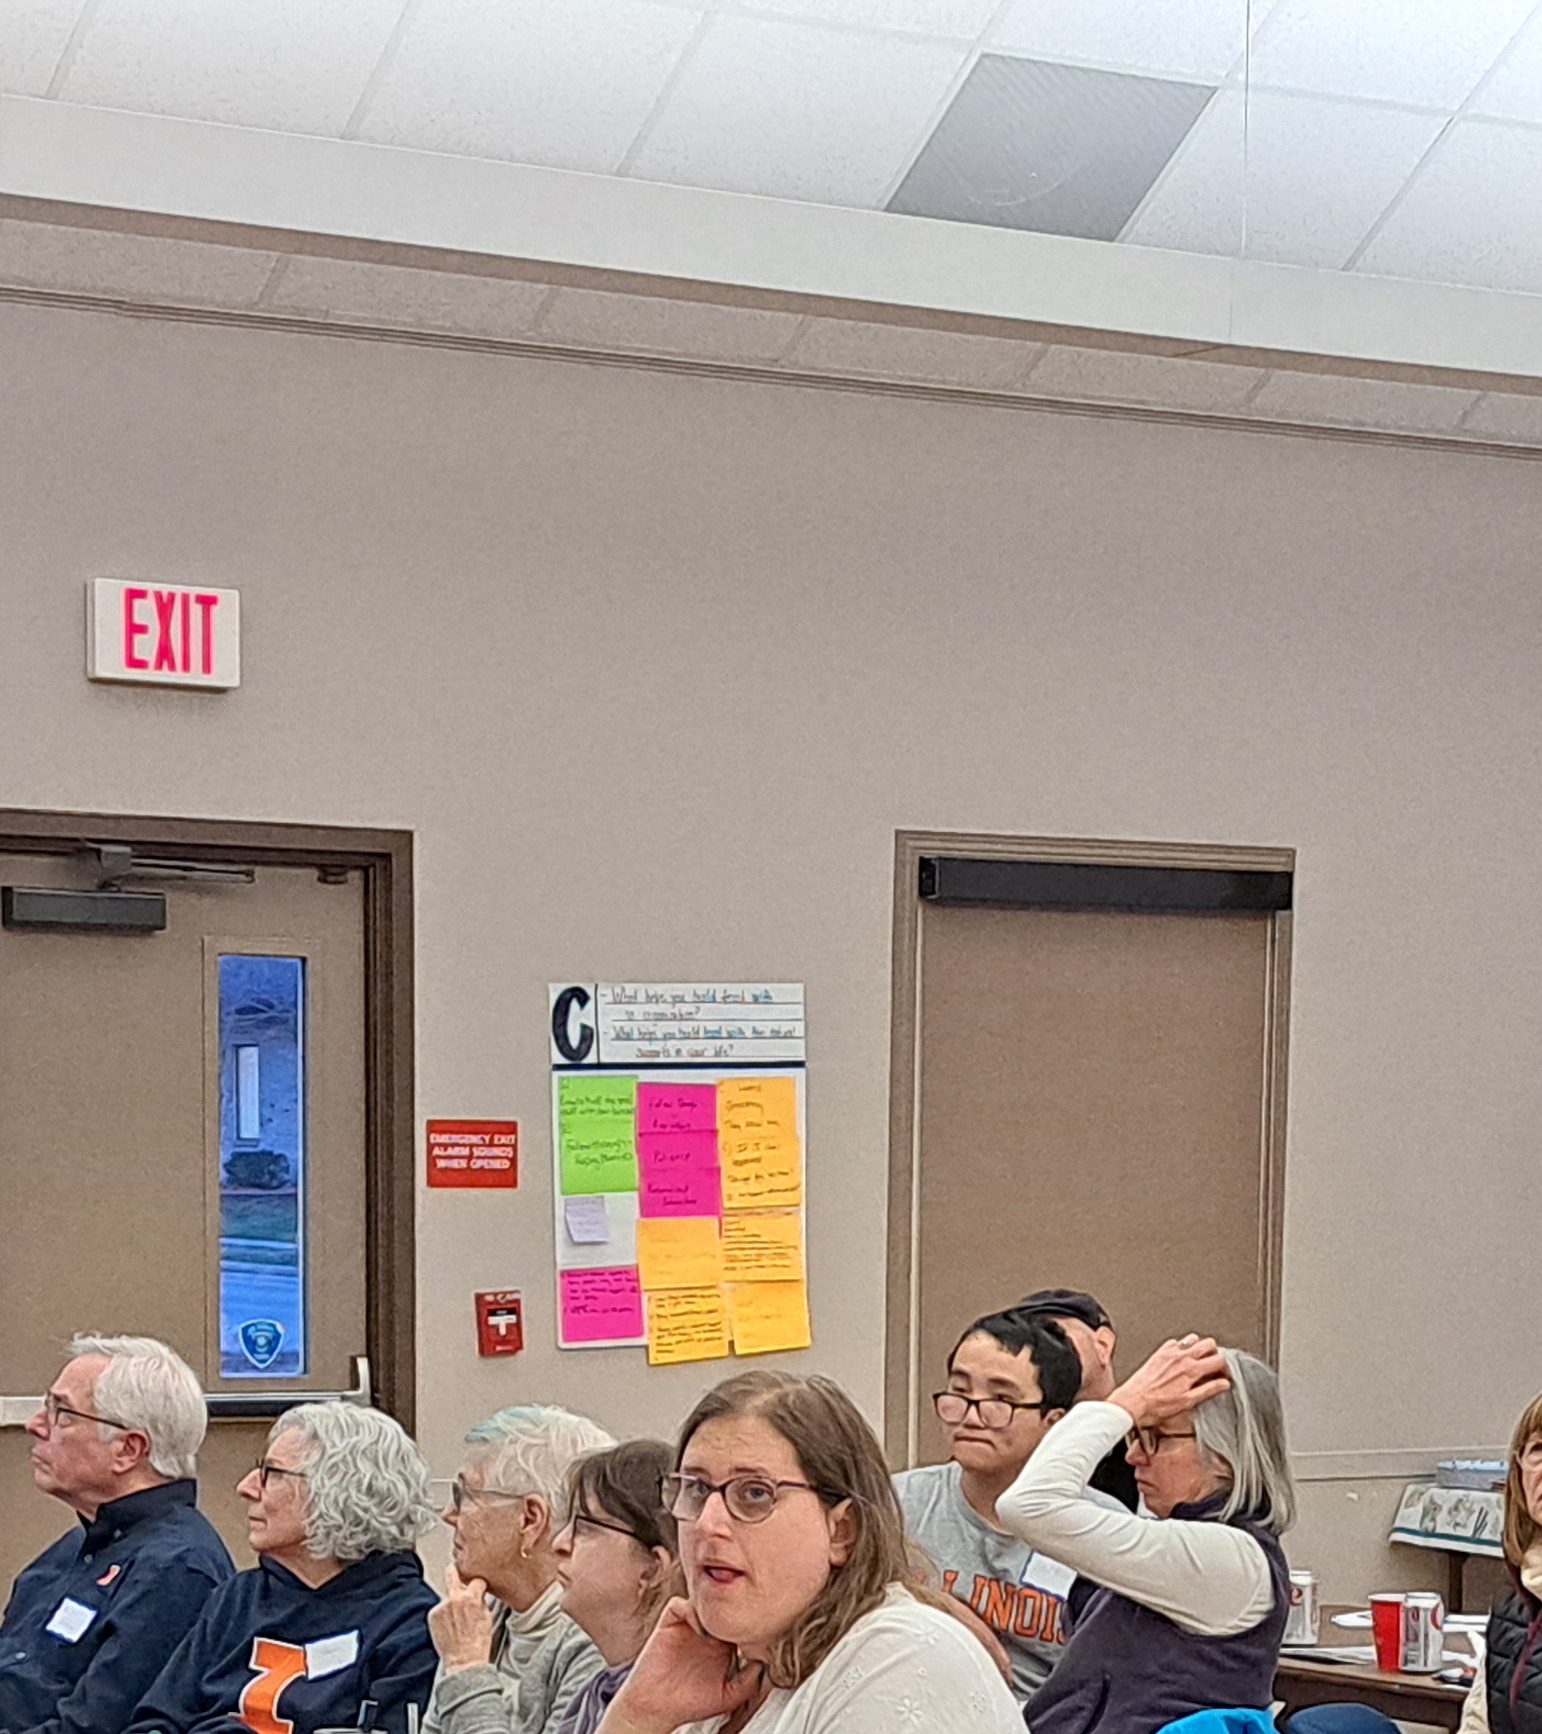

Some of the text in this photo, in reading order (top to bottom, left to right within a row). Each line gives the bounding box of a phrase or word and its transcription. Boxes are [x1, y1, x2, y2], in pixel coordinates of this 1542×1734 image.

[124, 587, 218, 675] EXIT
[551, 986, 595, 1062] C
[432, 1146, 470, 1157] ALARM
[470, 1158, 511, 1170] OPENED
[913, 1569, 1069, 1646] INOI
